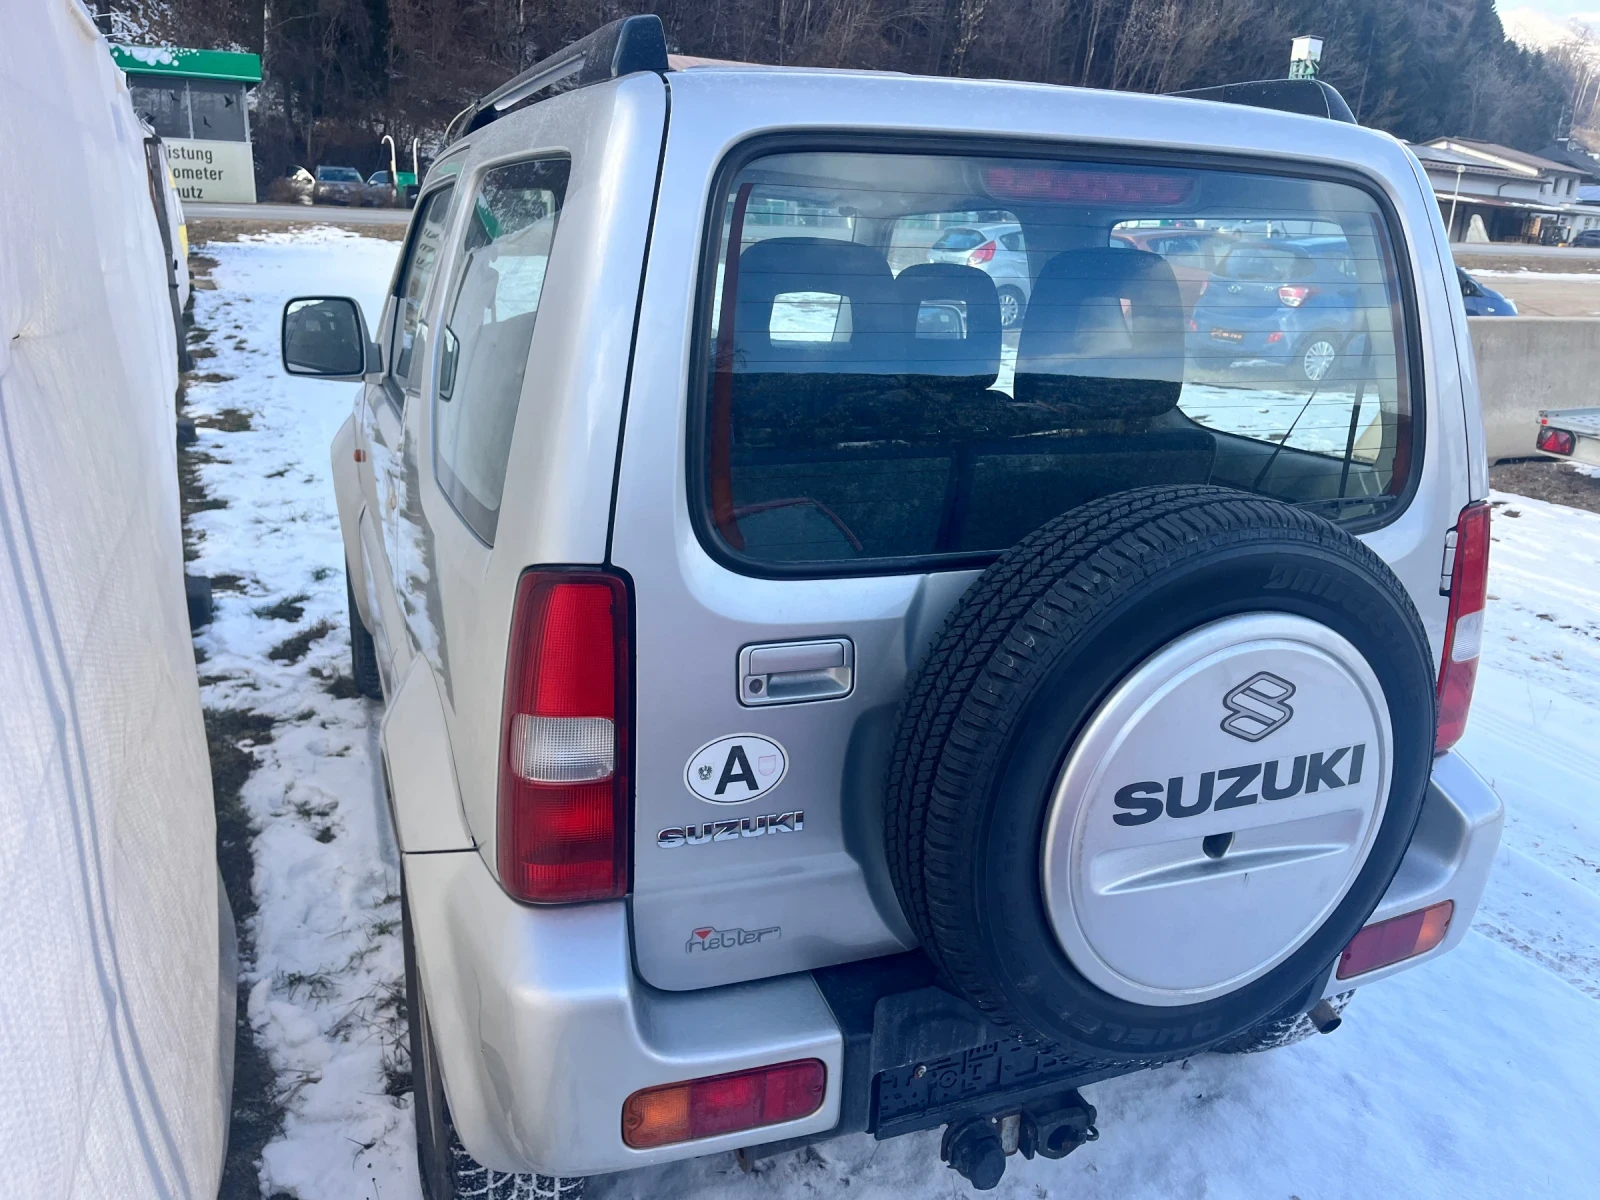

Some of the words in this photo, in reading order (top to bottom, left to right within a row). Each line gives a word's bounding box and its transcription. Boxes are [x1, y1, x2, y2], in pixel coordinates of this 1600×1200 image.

[167, 144, 213, 164] istung
[173, 167, 224, 181] ometer
[714, 744, 760, 795] A
[1112, 743, 1366, 827] SUZUKI
[657, 810, 804, 849] SUZUKI
